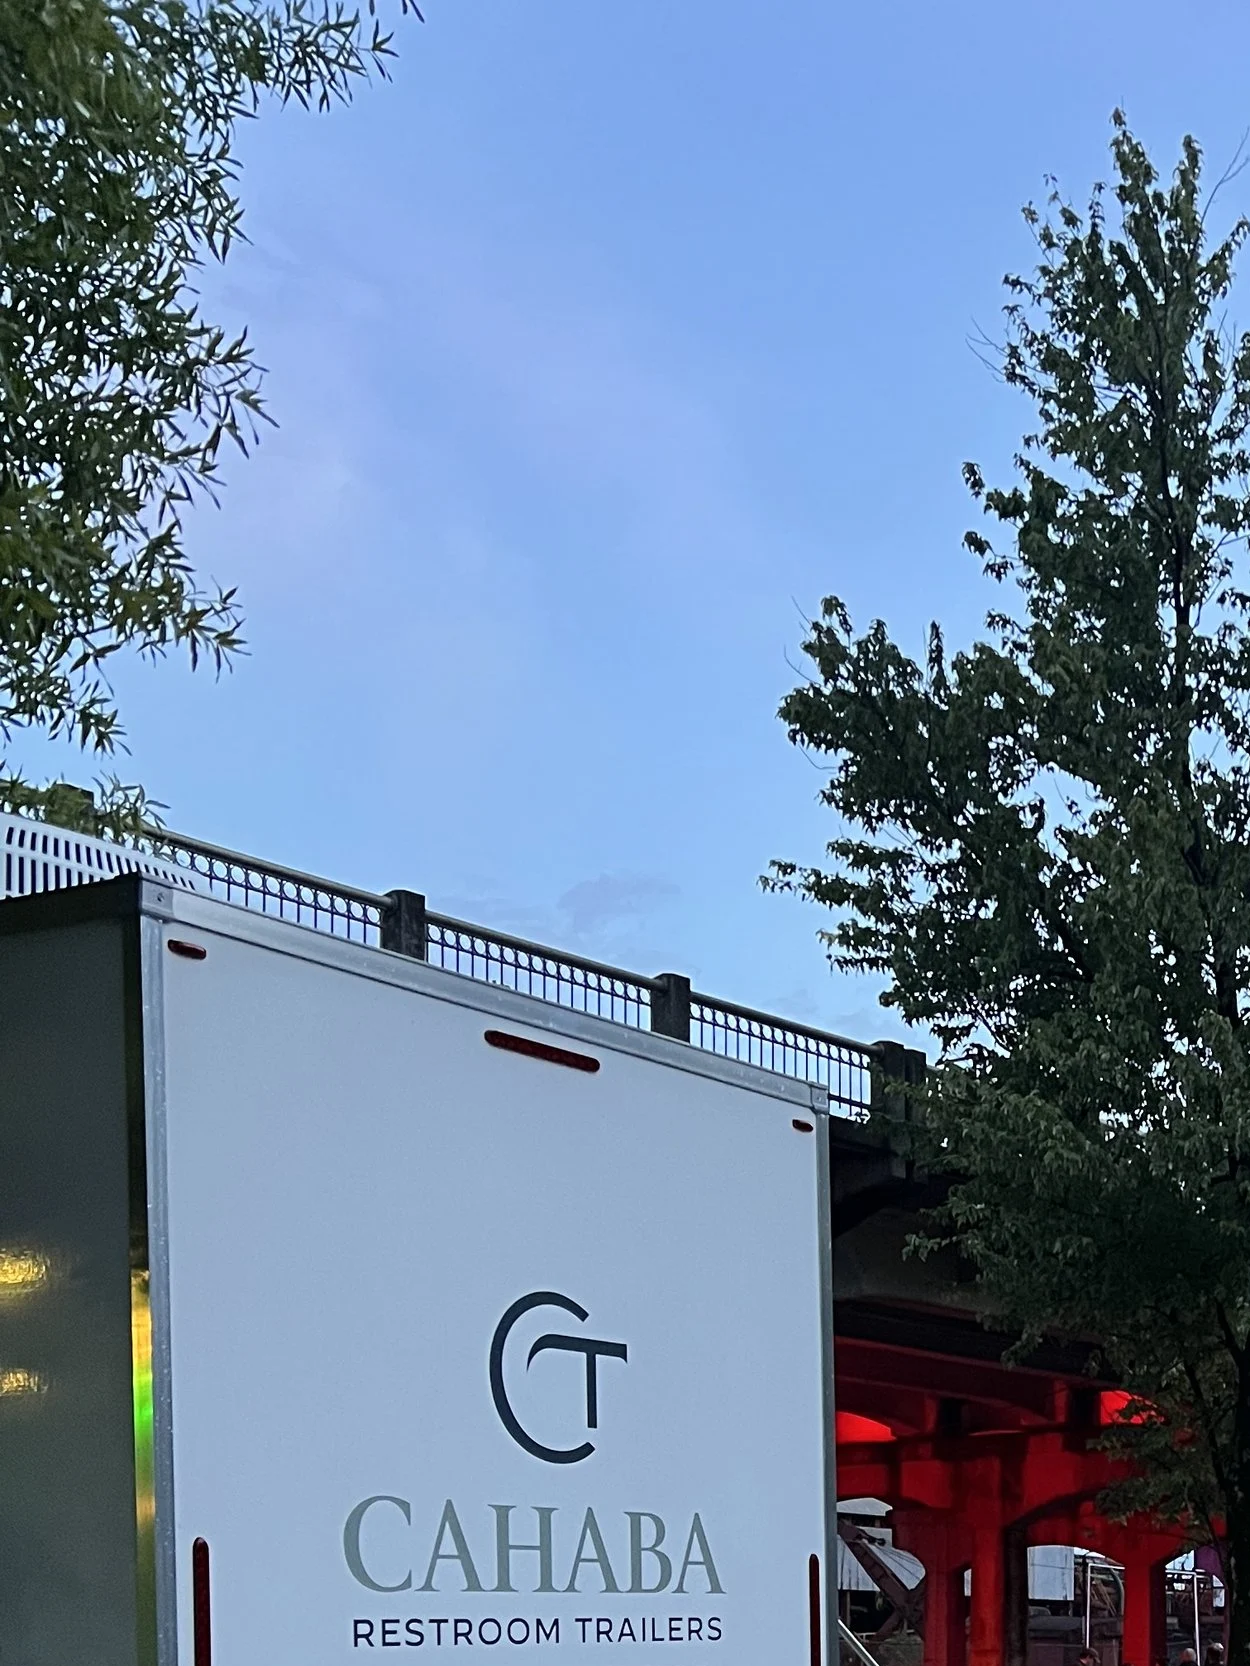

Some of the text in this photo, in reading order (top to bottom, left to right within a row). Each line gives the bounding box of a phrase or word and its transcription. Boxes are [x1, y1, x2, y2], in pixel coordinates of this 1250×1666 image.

[343, 1495, 727, 1594] CAHABA
[353, 1616, 722, 1647] RESTROOM TRAILERS
